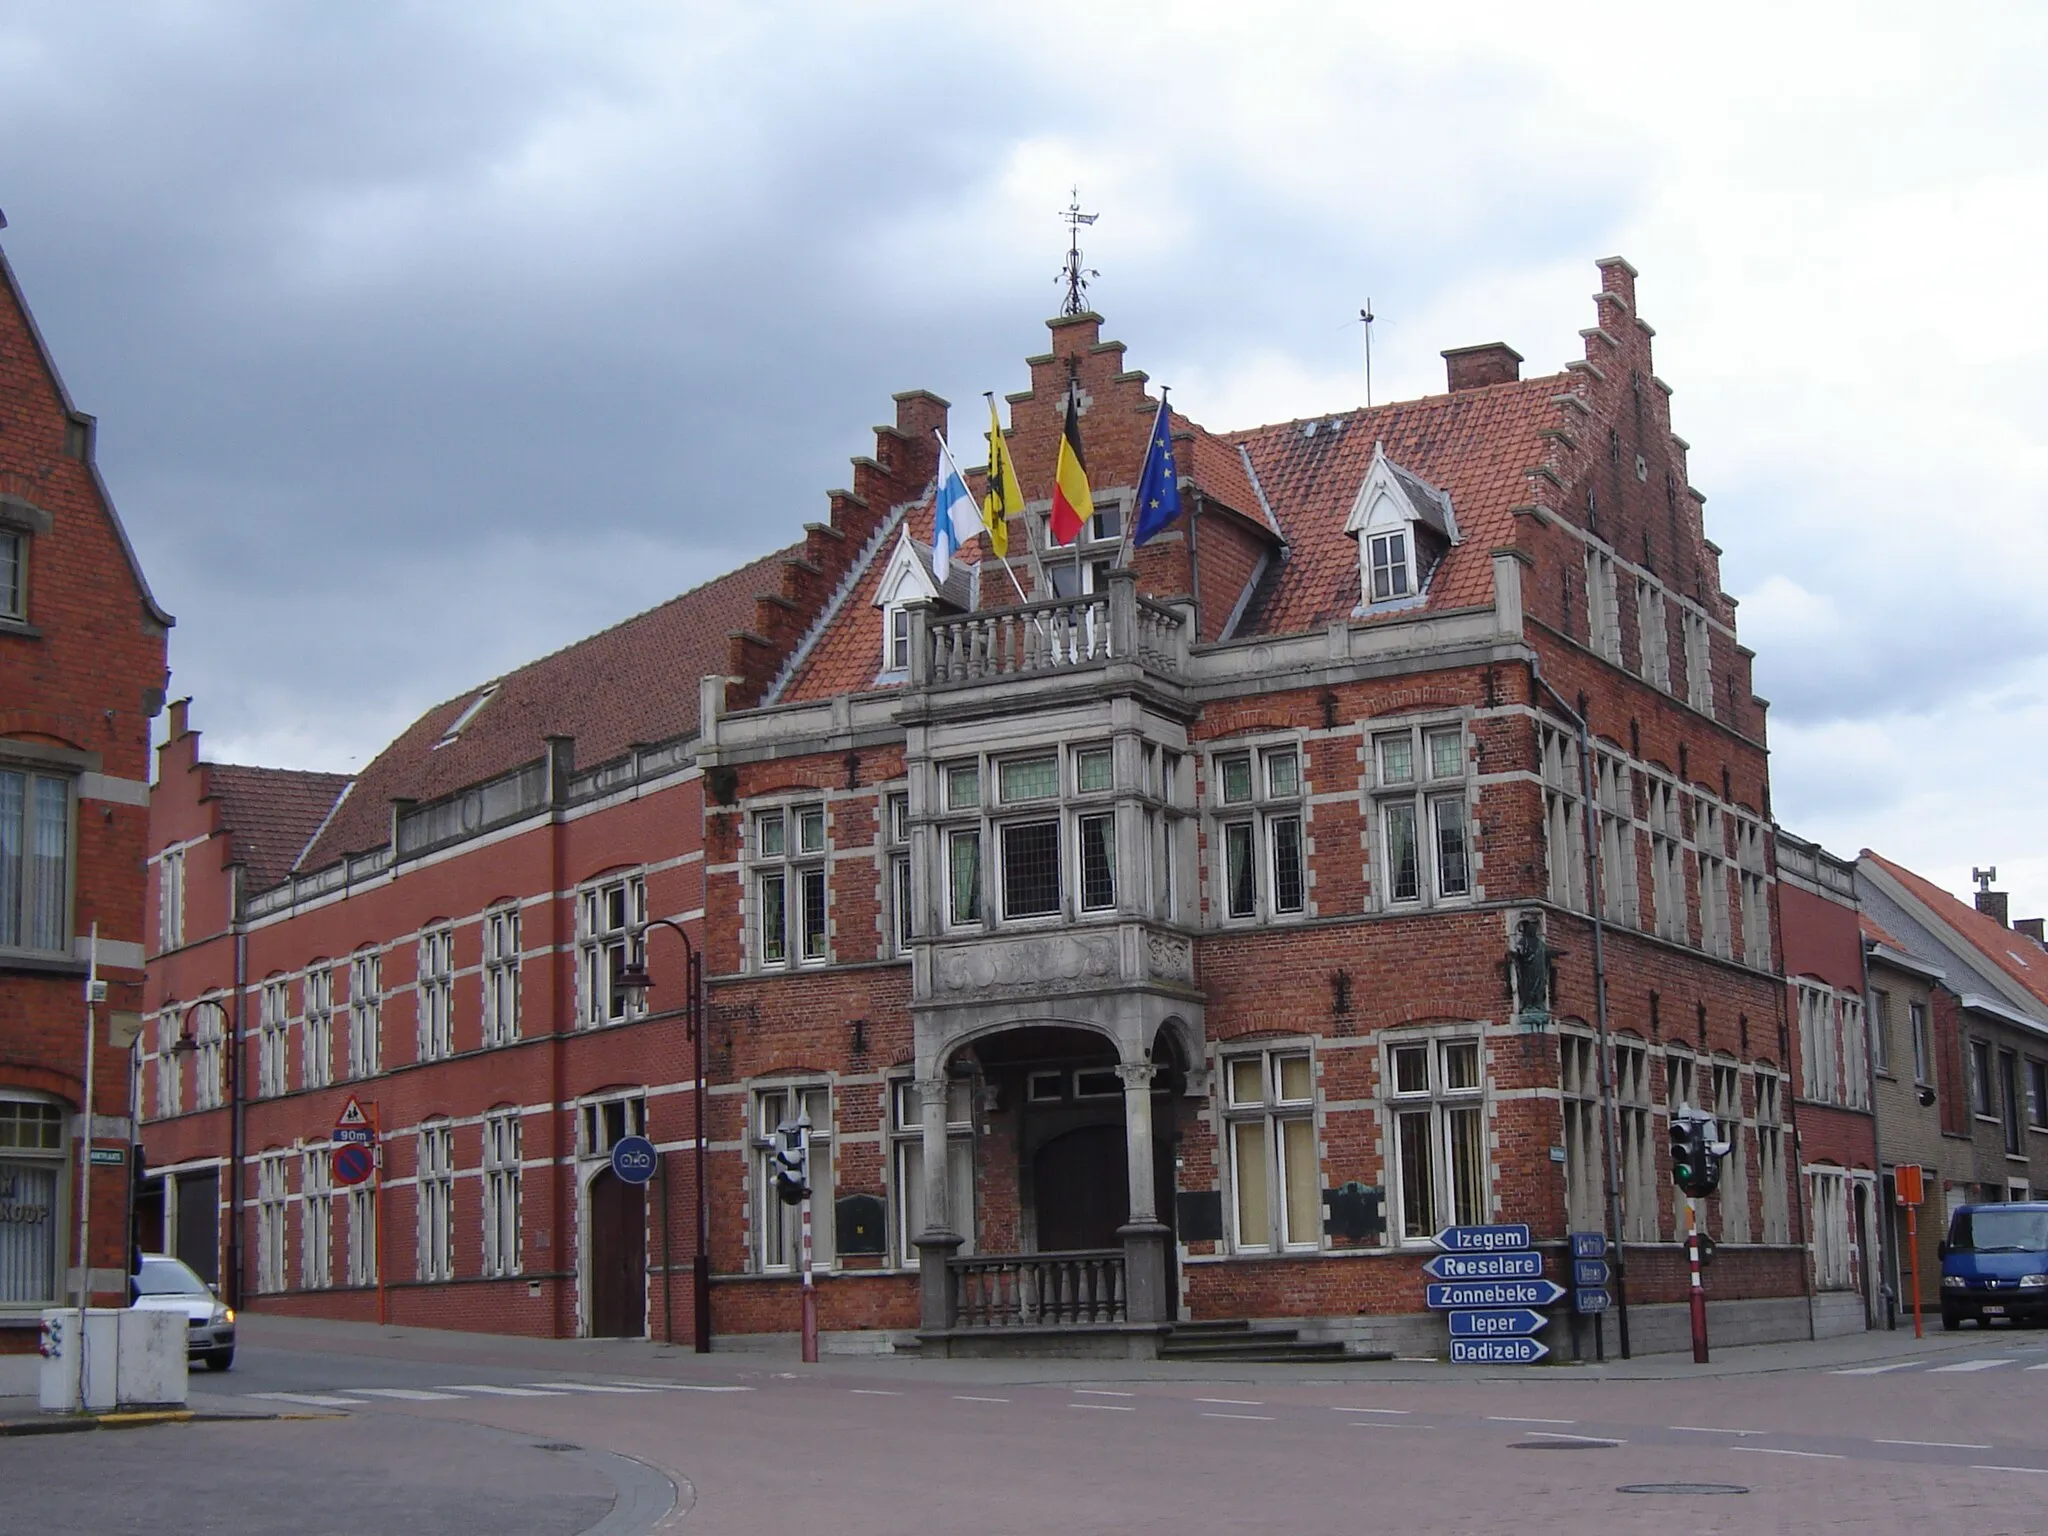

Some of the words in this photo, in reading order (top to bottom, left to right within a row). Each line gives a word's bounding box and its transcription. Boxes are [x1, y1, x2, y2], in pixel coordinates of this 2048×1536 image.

[341, 1131, 367, 1141] 90m
[1456, 1230, 1522, 1250] Izegem
[1445, 1258, 1535, 1276] Roeselare
[1441, 1285, 1537, 1304] Zonnebeke
[1471, 1316, 1517, 1335] Ieper
[1455, 1342, 1531, 1360] Dadizele
